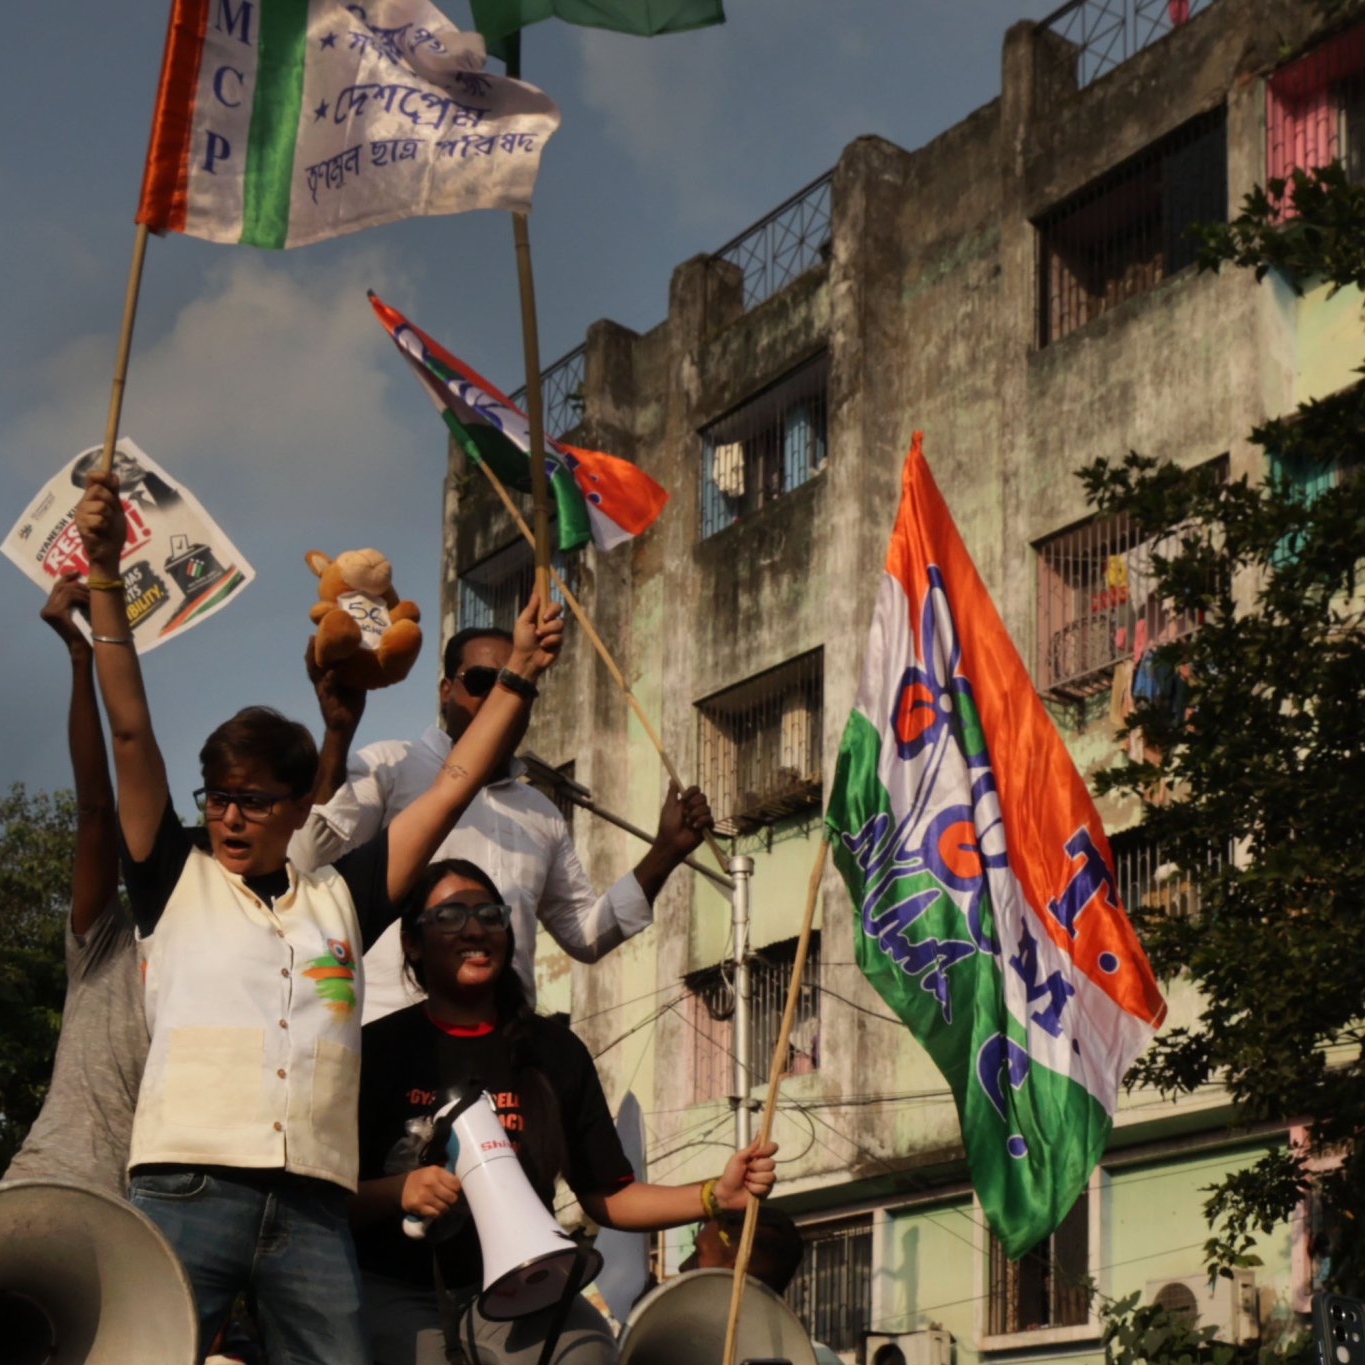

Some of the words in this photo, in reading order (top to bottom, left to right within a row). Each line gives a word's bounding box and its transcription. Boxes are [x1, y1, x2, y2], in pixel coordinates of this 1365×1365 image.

[305, 144, 362, 204] তৃণমূল
[370, 139, 426, 166] ছাত্র
[435, 133, 539, 158] পরিষদ
[49, 523, 83, 568] RES
